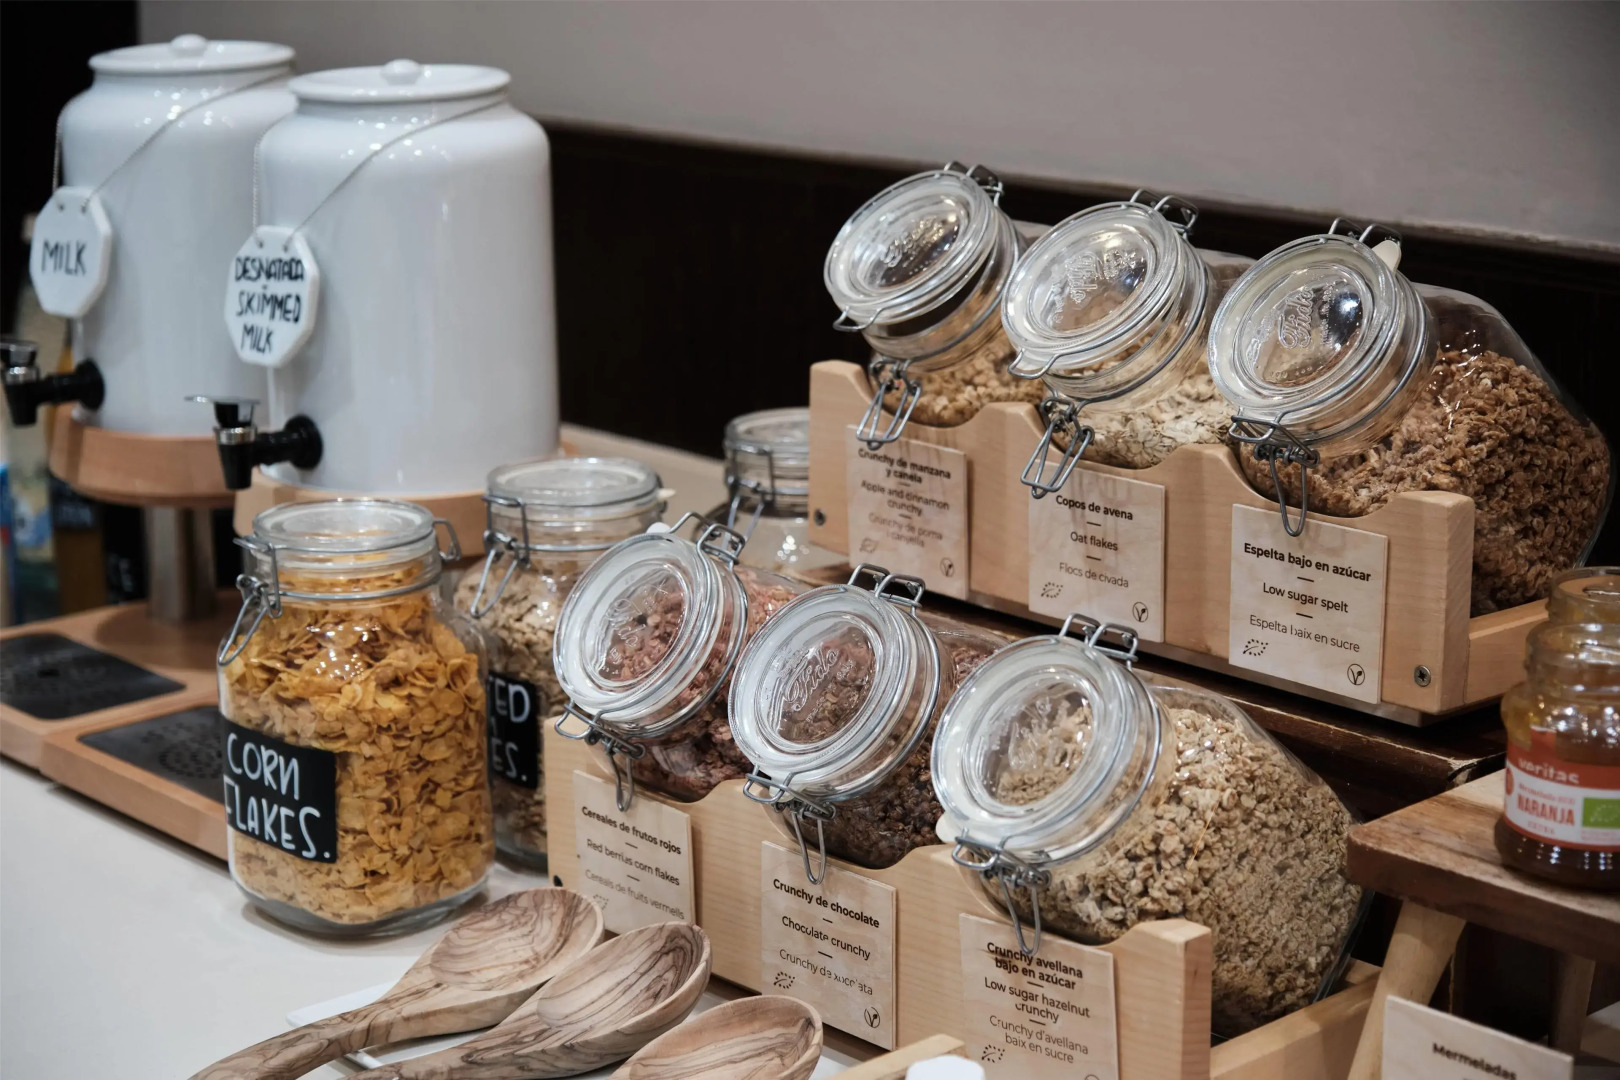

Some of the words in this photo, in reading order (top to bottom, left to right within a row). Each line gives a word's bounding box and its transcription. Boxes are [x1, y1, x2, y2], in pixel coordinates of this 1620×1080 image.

[41, 240, 86, 275] MILK
[236, 290, 301, 324] SKIMMED
[241, 323, 273, 355] MILK
[858, 448, 894, 467] Crunchy
[896, 458, 908, 468] de
[909, 462, 951, 479] manzana
[885, 468, 892, 478] y
[893, 470, 923, 484] canela
[861, 480, 885, 494] Apple
[887, 486, 904, 499] and
[905, 492, 950, 511] cinnamon
[1055, 495, 1086, 511] Copos
[1088, 502, 1101, 513] de
[1103, 505, 1134, 521] avena
[868, 512, 903, 531] Crunchy
[904, 523, 916, 534] de
[1070, 531, 1088, 545] Oat
[1089, 535, 1118, 551] flakes
[1059, 562, 1083, 577] Flocs
[1084, 569, 1097, 581] de
[1098, 572, 1129, 588] civada
[1244, 542, 1285, 562] Espelta
[1288, 552, 1313, 569] bajo
[1315, 560, 1329, 573] en
[1332, 563, 1372, 582] azúcar
[1263, 582, 1286, 597] Low
[1287, 590, 1319, 605] sugar
[1320, 598, 1349, 613] spelt
[1250, 614, 1288, 634] Espelta
[1290, 624, 1312, 641] baix
[1314, 633, 1328, 645] en
[1330, 637, 1360, 653] sucre
[781, 645, 839, 712] Fido
[227, 732, 299, 800] CORN
[1518, 757, 1580, 784] veritas
[223, 774, 331, 860] FLAKES.
[1517, 793, 1576, 827] NARANJA
[582, 806, 617, 829] Cereales
[619, 822, 630, 834] de
[632, 826, 658, 845] frutos
[659, 838, 682, 855] rojos
[587, 838, 603, 853] Red
[634, 859, 654, 874] corn
[655, 867, 680, 886] flakes
[585, 869, 614, 889] Cereals
[615, 881, 626, 894] de
[627, 887, 649, 905] fruits
[649, 899, 685, 920] vermells
[773, 878, 814, 904] Crunchy
[815, 895, 828, 908] de
[831, 901, 880, 928] chocolate
[781, 915, 829, 941] Chocolate
[831, 937, 871, 961] crunchy
[779, 949, 818, 976] Crunchy
[987, 942, 1033, 966] Crunchy
[1036, 957, 1083, 978] avellana
[995, 957, 1019, 974] bajo
[1022, 967, 1035, 979] en
[1038, 973, 1076, 990] azúcar
[984, 977, 1006, 992] Low
[1009, 986, 1039, 1002] sugar
[1041, 994, 1091, 1018] hazelnut
[1005, 1033, 1026, 1050] baix
[1029, 1041, 1043, 1053] en
[1045, 1046, 1074, 1064] sucre
[1035, 1029, 1089, 1055] d'avellana
[1432, 1042, 1518, 1080] Mermeladas
